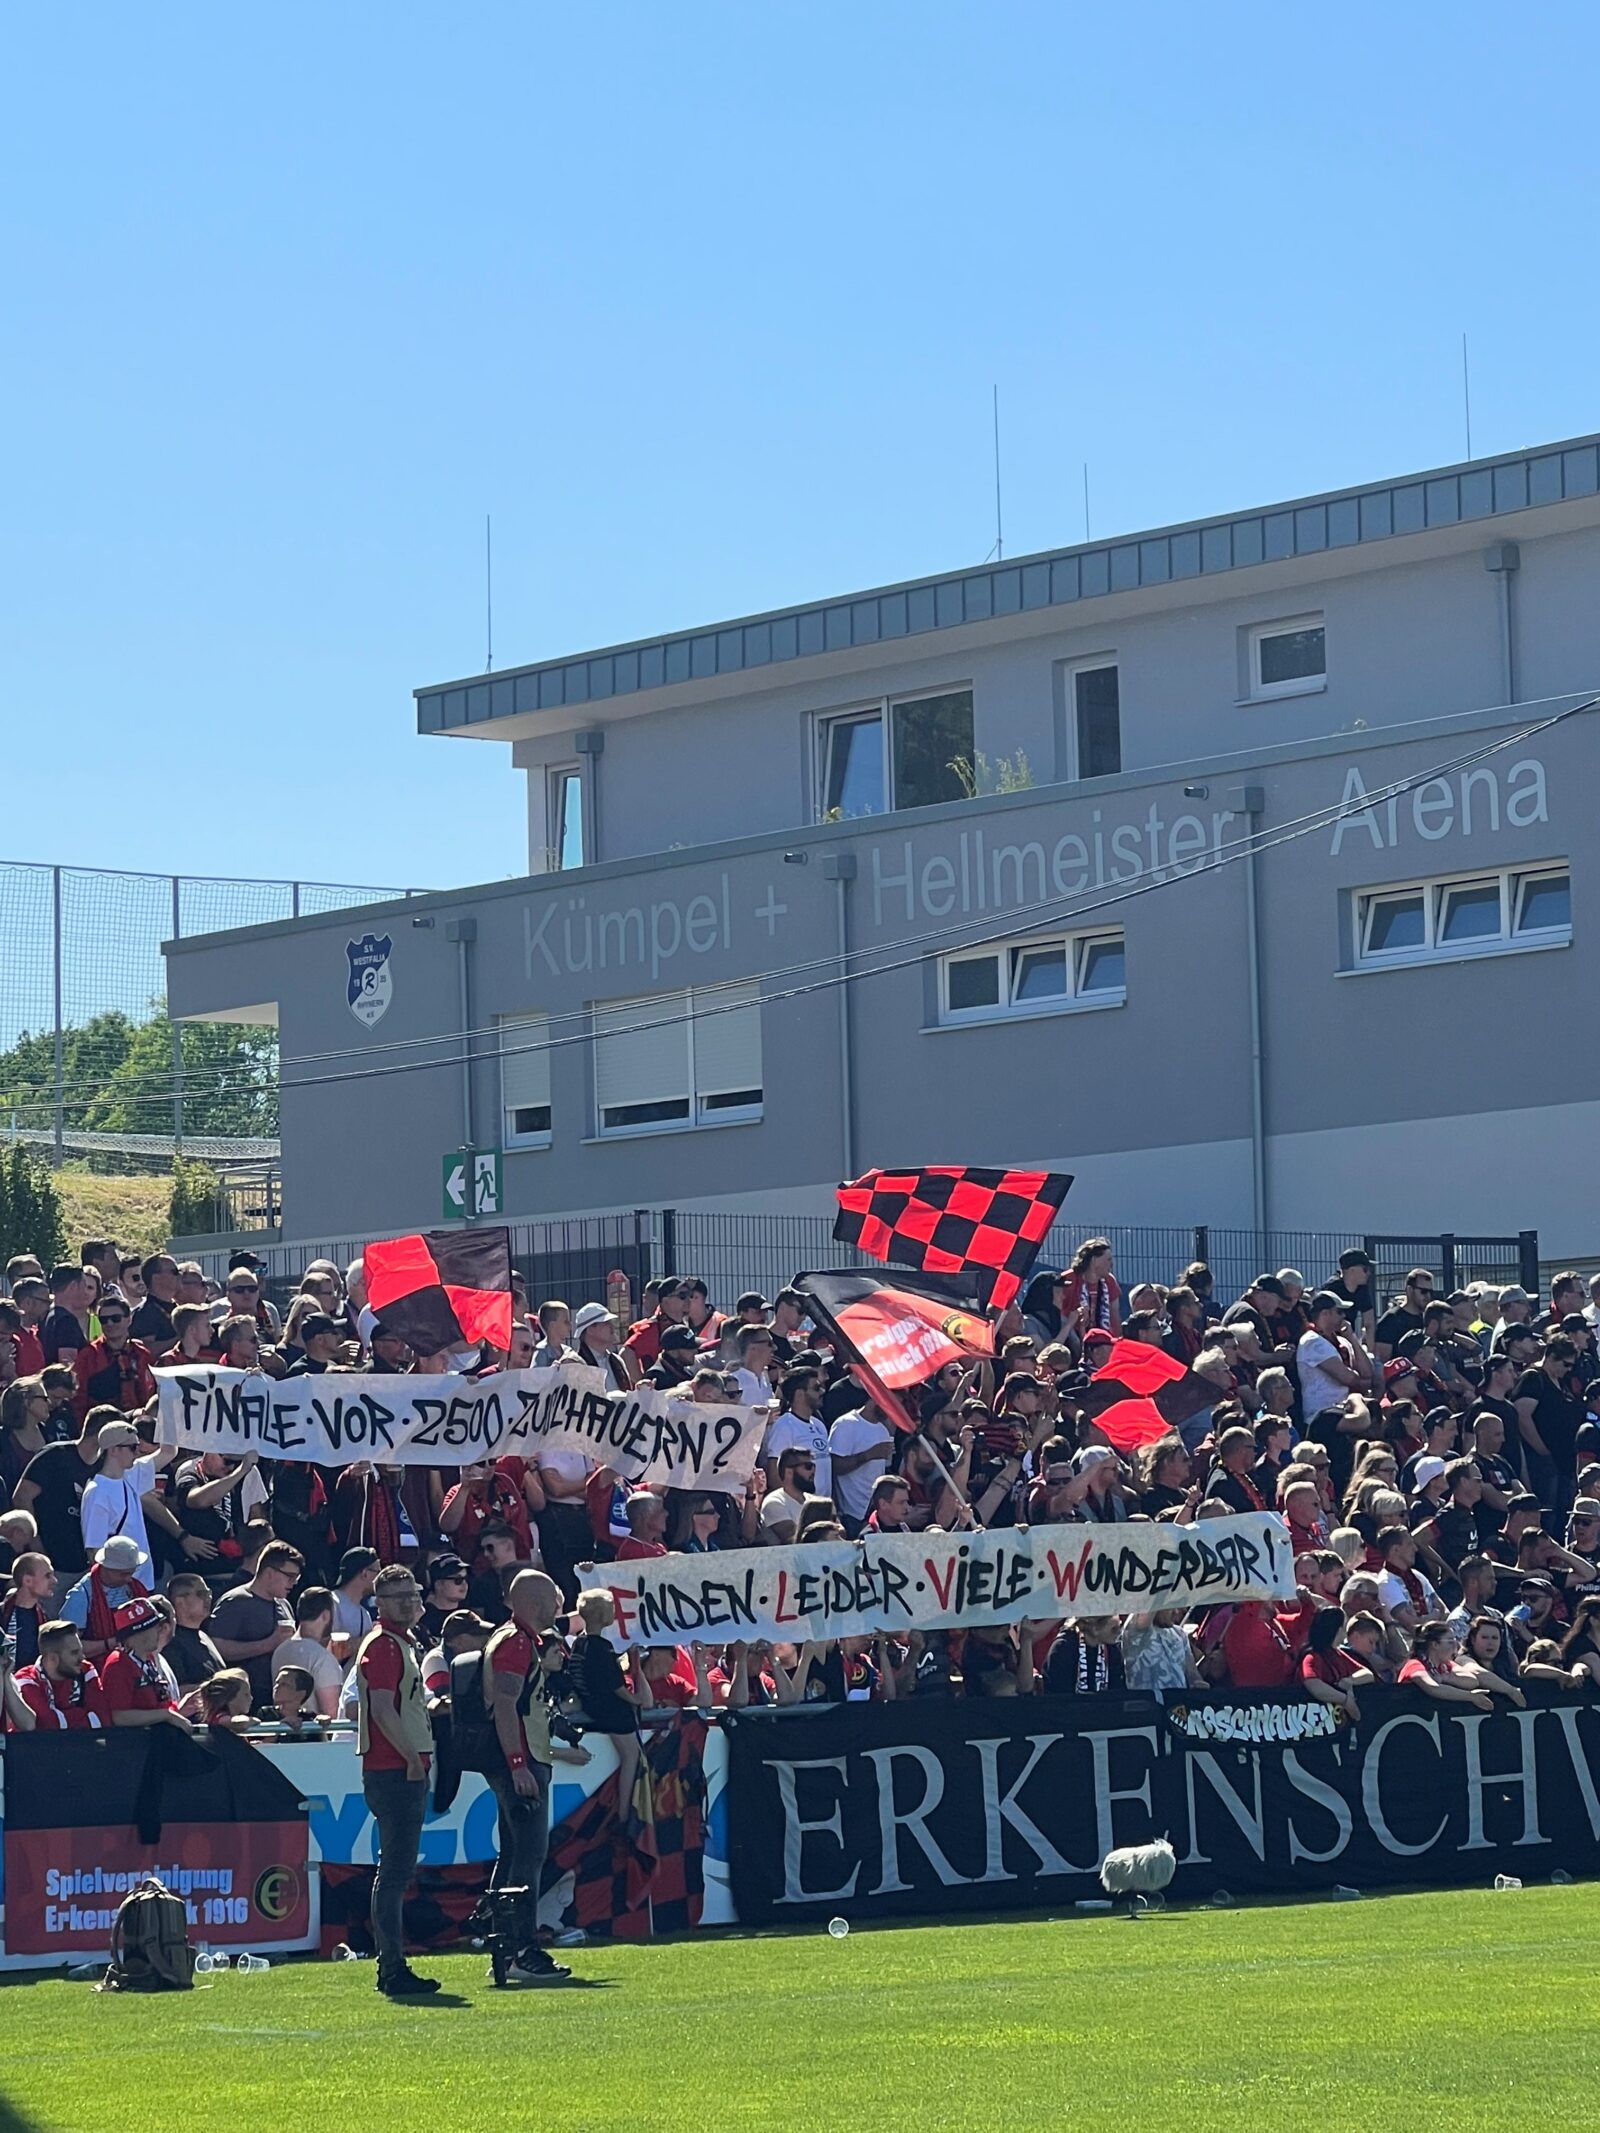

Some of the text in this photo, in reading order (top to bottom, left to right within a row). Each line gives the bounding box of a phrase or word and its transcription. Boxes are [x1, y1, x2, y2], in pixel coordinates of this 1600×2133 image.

[523, 872, 732, 980] Kümpel
[872, 801, 1235, 926] Hellmeister
[1330, 759, 1549, 856] Arena
[353, 953, 386, 966] WESTFALIA
[311, 1393, 395, 1449] VOR
[411, 1392, 503, 1448] 2500
[203, 1897, 248, 1925] 1916
